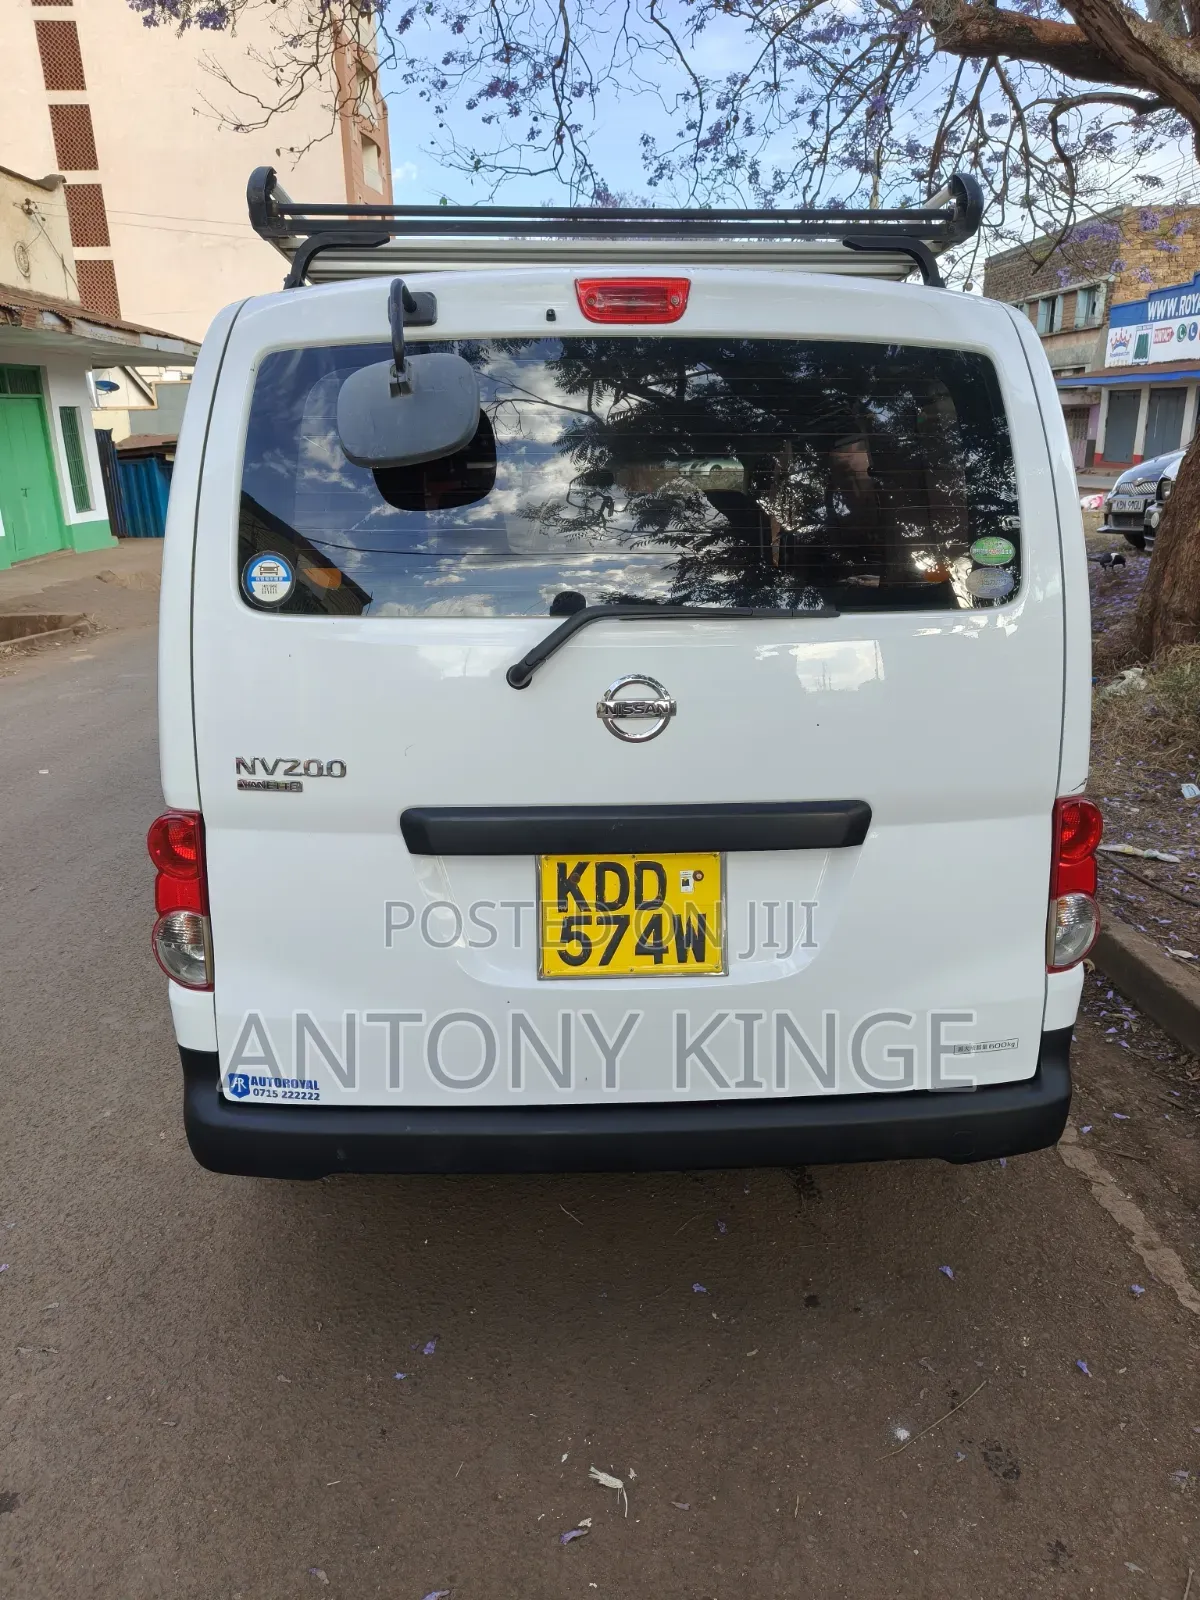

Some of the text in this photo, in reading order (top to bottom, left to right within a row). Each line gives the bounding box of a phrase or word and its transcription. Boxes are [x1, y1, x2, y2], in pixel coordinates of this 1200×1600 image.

[605, 702, 669, 715] NISSAN
[235, 756, 347, 778] NV200
[240, 780, 301, 791] VANETTE
[557, 860, 668, 913] KDD
[556, 913, 707, 967] 574W
[250, 1076, 320, 1091] AUTOROYAL
[252, 1088, 321, 1101] 0715 222222
